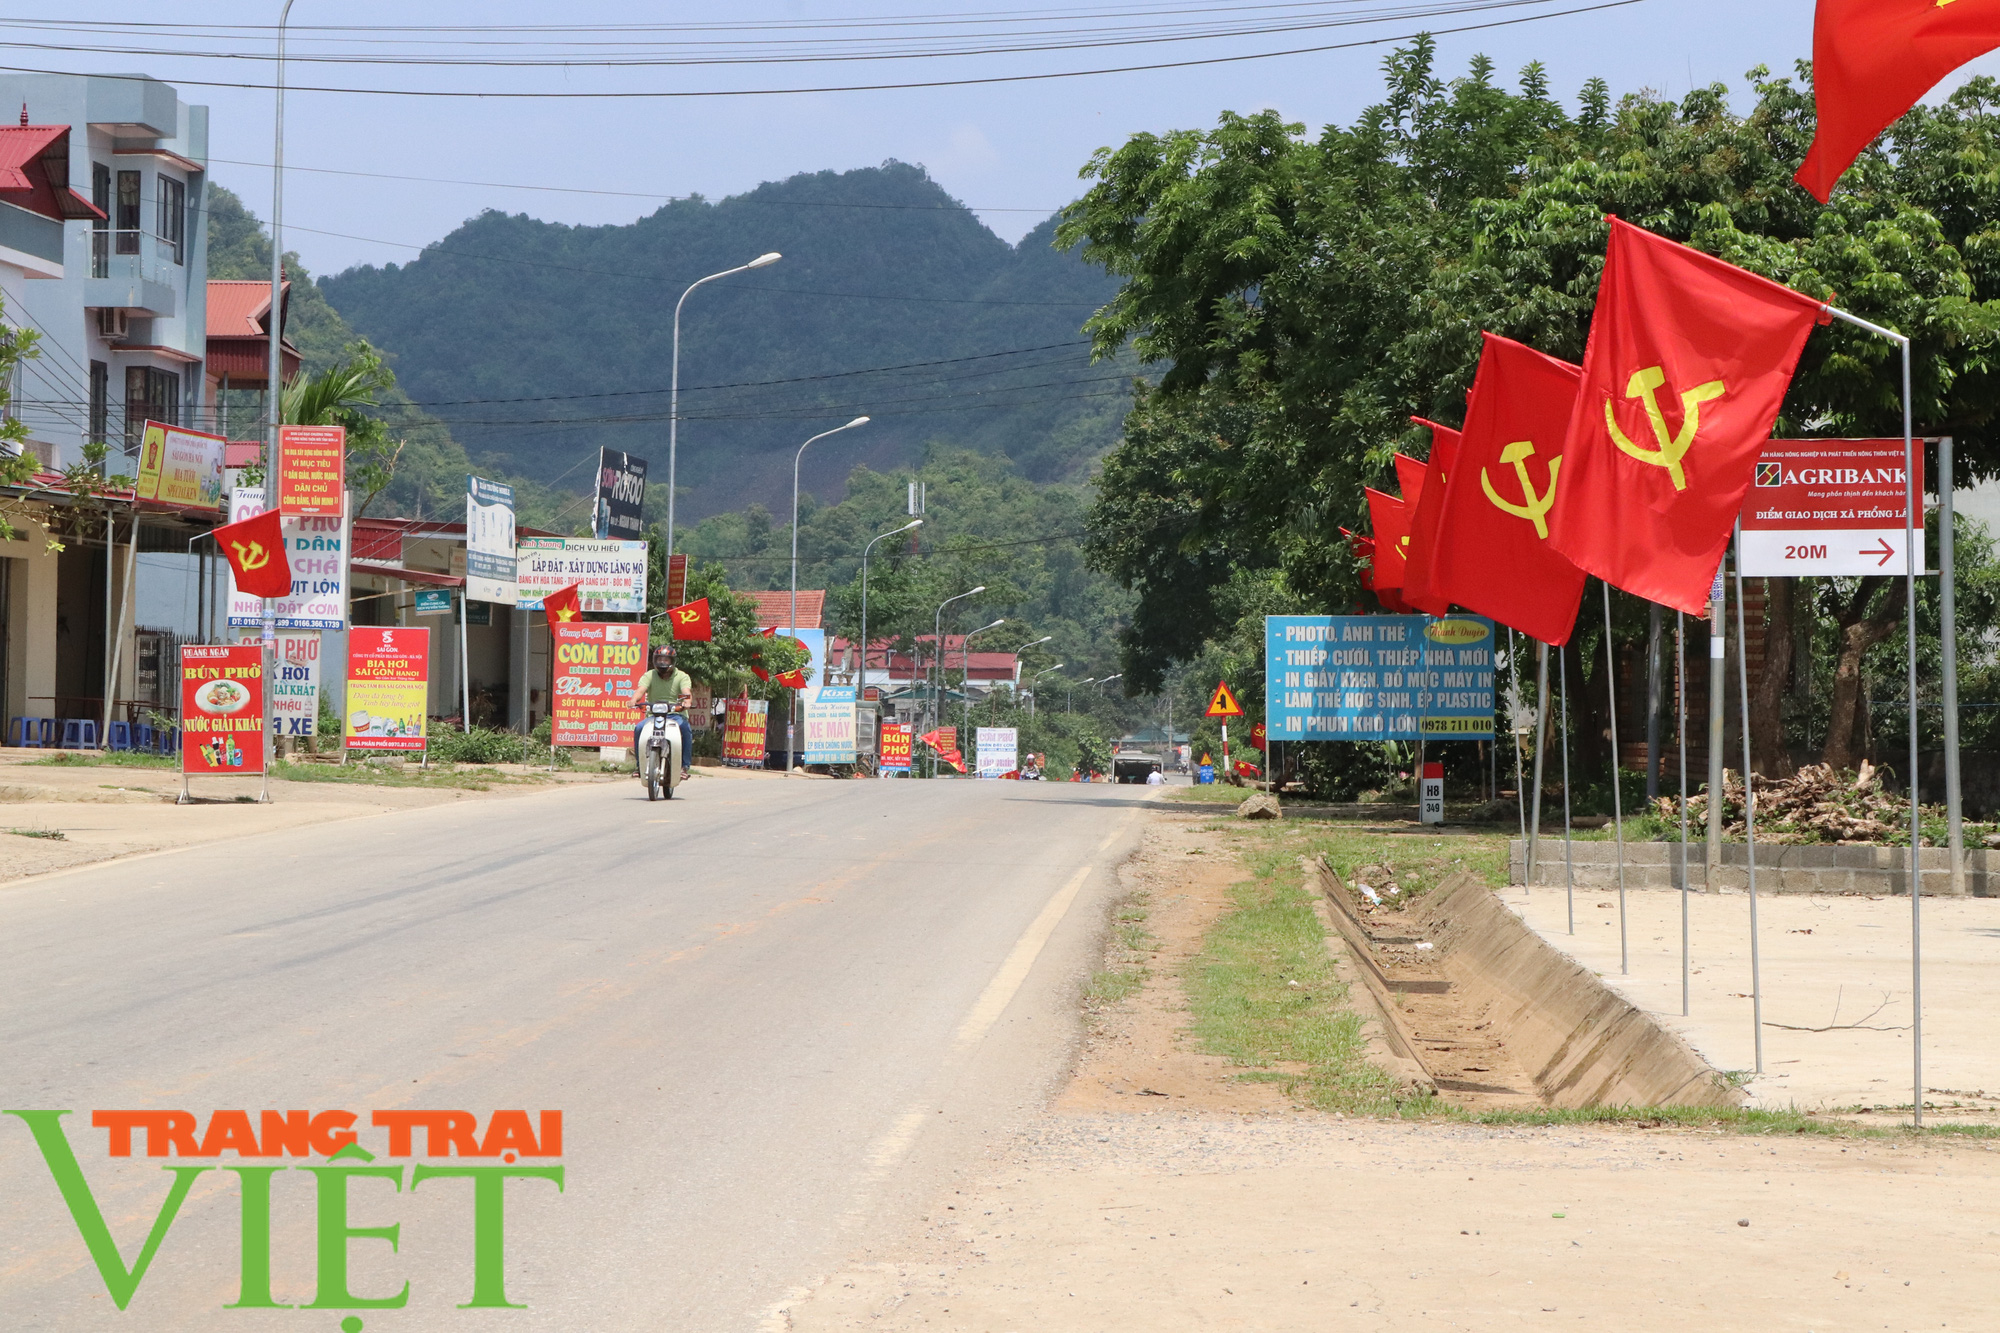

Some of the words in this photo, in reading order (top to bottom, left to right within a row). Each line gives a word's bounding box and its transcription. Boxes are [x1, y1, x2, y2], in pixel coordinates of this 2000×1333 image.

[1800, 450, 1820, 458] NGHIỆP
[300, 460, 315, 469] MỤC
[316, 459, 331, 468] TIÊU
[1782, 468, 1906, 484] AGRIBANK
[294, 483, 310, 492] DÂN
[312, 482, 328, 492] CHỦ
[236, 490, 265, 501] Trung
[1756, 507, 1783, 519] ĐIỂM
[1785, 511, 1810, 519] GIAO
[1813, 511, 1838, 520] DỊCH
[1840, 509, 1855, 518] XÃ
[1895, 508, 1906, 518] LÁ
[296, 535, 340, 551] DÂN
[520, 539, 536, 548] Vinh
[601, 542, 620, 552] HIẾU
[1785, 545, 1827, 559] 20M
[294, 555, 338, 574] CHẢ
[532, 554, 546, 572] LẮP
[569, 558, 584, 572] XÂY
[586, 560, 608, 576] DỰNG
[610, 560, 630, 574] LĂNG
[290, 581, 308, 595] VỊT
[313, 579, 340, 596] LỘN
[585, 576, 599, 586] SANG
[234, 599, 262, 616] NHẬ
[277, 600, 303, 617] ĐẶT
[308, 603, 338, 615] CƠM
[294, 620, 340, 628] 0166.366.1739
[560, 628, 581, 638] Trung
[1286, 626, 1338, 642] PHOTO,
[1342, 622, 1373, 641] ẢNH
[1378, 622, 1406, 641] THẺ
[285, 630, 320, 660] PHỞ
[558, 642, 600, 664] CƠM
[602, 637, 642, 665] PHỞ
[1285, 645, 1328, 666] THIẾP
[1332, 648, 1374, 667] CƯỚI,
[1377, 645, 1420, 666] THIẾP
[1424, 648, 1455, 666] NHÀ
[1459, 648, 1489, 666] MỚI
[367, 660, 385, 668] BIA
[388, 659, 408, 668] HƠI
[569, 665, 600, 674] BÌNH
[603, 666, 631, 675] DÂN
[184, 665, 219, 679] BÚN
[224, 663, 261, 679] PHỞ
[282, 666, 309, 681] HƠI
[355, 668, 370, 676] SAI
[372, 668, 394, 676] GON
[1285, 672, 1300, 688] IN
[1304, 667, 1336, 688] GIẤY
[1341, 672, 1380, 688] KHEN,
[1384, 666, 1403, 688] ĐỔ
[1444, 670, 1473, 688] MÁY
[1478, 672, 1492, 688] IN
[290, 683, 315, 696] KHÁT
[556, 676, 602, 696] Bún
[273, 698, 301, 712] NHẬU
[602, 698, 620, 708] LÒNG
[696, 698, 708, 709] XE
[1285, 690, 1313, 708] LÀM
[1316, 689, 1342, 708] THẺ
[1345, 692, 1374, 711] HỌC
[1378, 692, 1413, 709] SINH,
[1437, 692, 1491, 708] PLASTIC
[570, 709, 584, 720] CẬT
[590, 709, 613, 719] TRỨNG
[615, 712, 625, 720] VỊT
[627, 711, 640, 721] LỘN
[1286, 716, 1302, 732] IN
[1306, 716, 1348, 732] PHUN
[1353, 711, 1384, 732] KHỔ
[1389, 714, 1416, 732] LỚN
[1422, 720, 1447, 730] 0978
[1451, 720, 1468, 730] 711
[1472, 720, 1492, 730] 010
[184, 715, 210, 732] NƯỚC
[211, 714, 233, 732] GIẢI
[235, 714, 262, 731] KHÁT
[288, 717, 312, 735] XE
[810, 722, 823, 738] XE
[827, 718, 850, 738] MÁY
[557, 732, 575, 742] RỬA
[576, 734, 587, 742] XE
[599, 733, 618, 742] KHÔ
[883, 733, 910, 743] BÚN
[724, 747, 742, 756] CAO
[745, 746, 762, 757] CẤP
[883, 744, 909, 755] PHỞ
[1426, 785, 1440, 797] H8
[1426, 803, 1440, 813] 349
